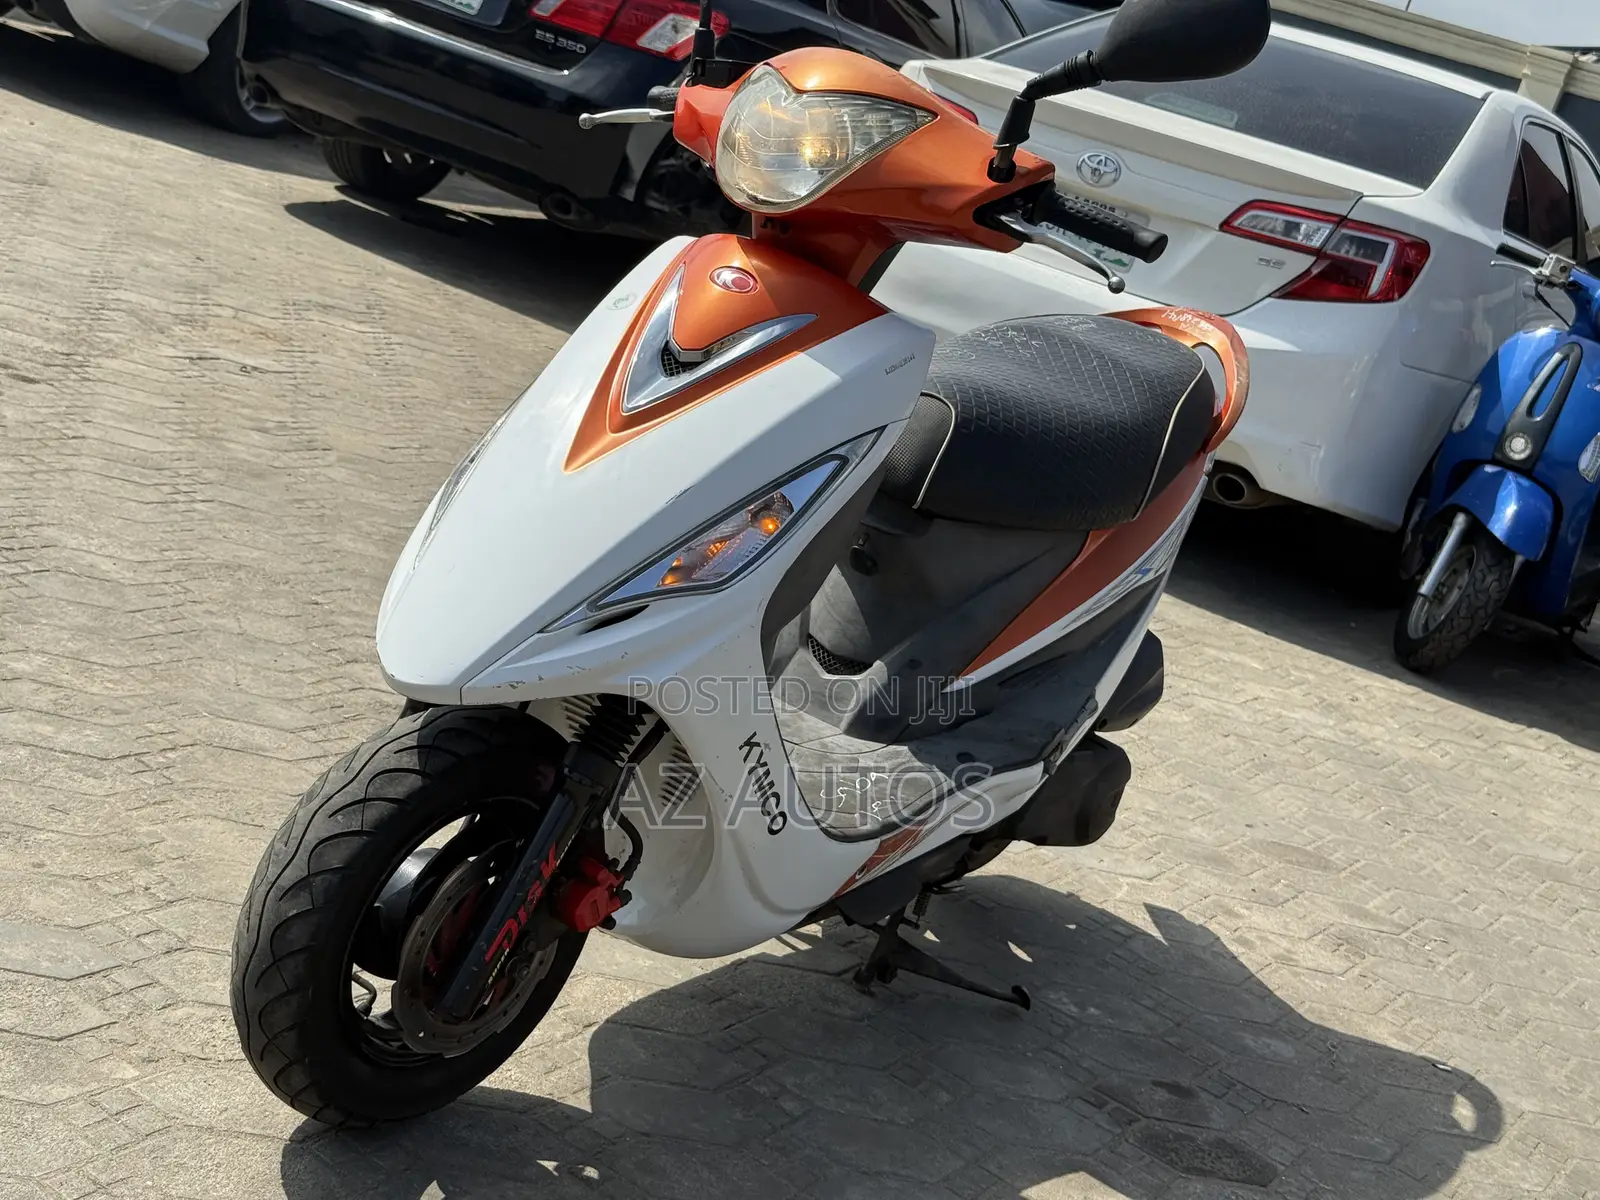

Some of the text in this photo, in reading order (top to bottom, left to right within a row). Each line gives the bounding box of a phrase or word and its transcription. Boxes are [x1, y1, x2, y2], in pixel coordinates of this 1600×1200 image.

[535, 29, 586, 53] ES 350
[738, 730, 788, 836] KYMCO
